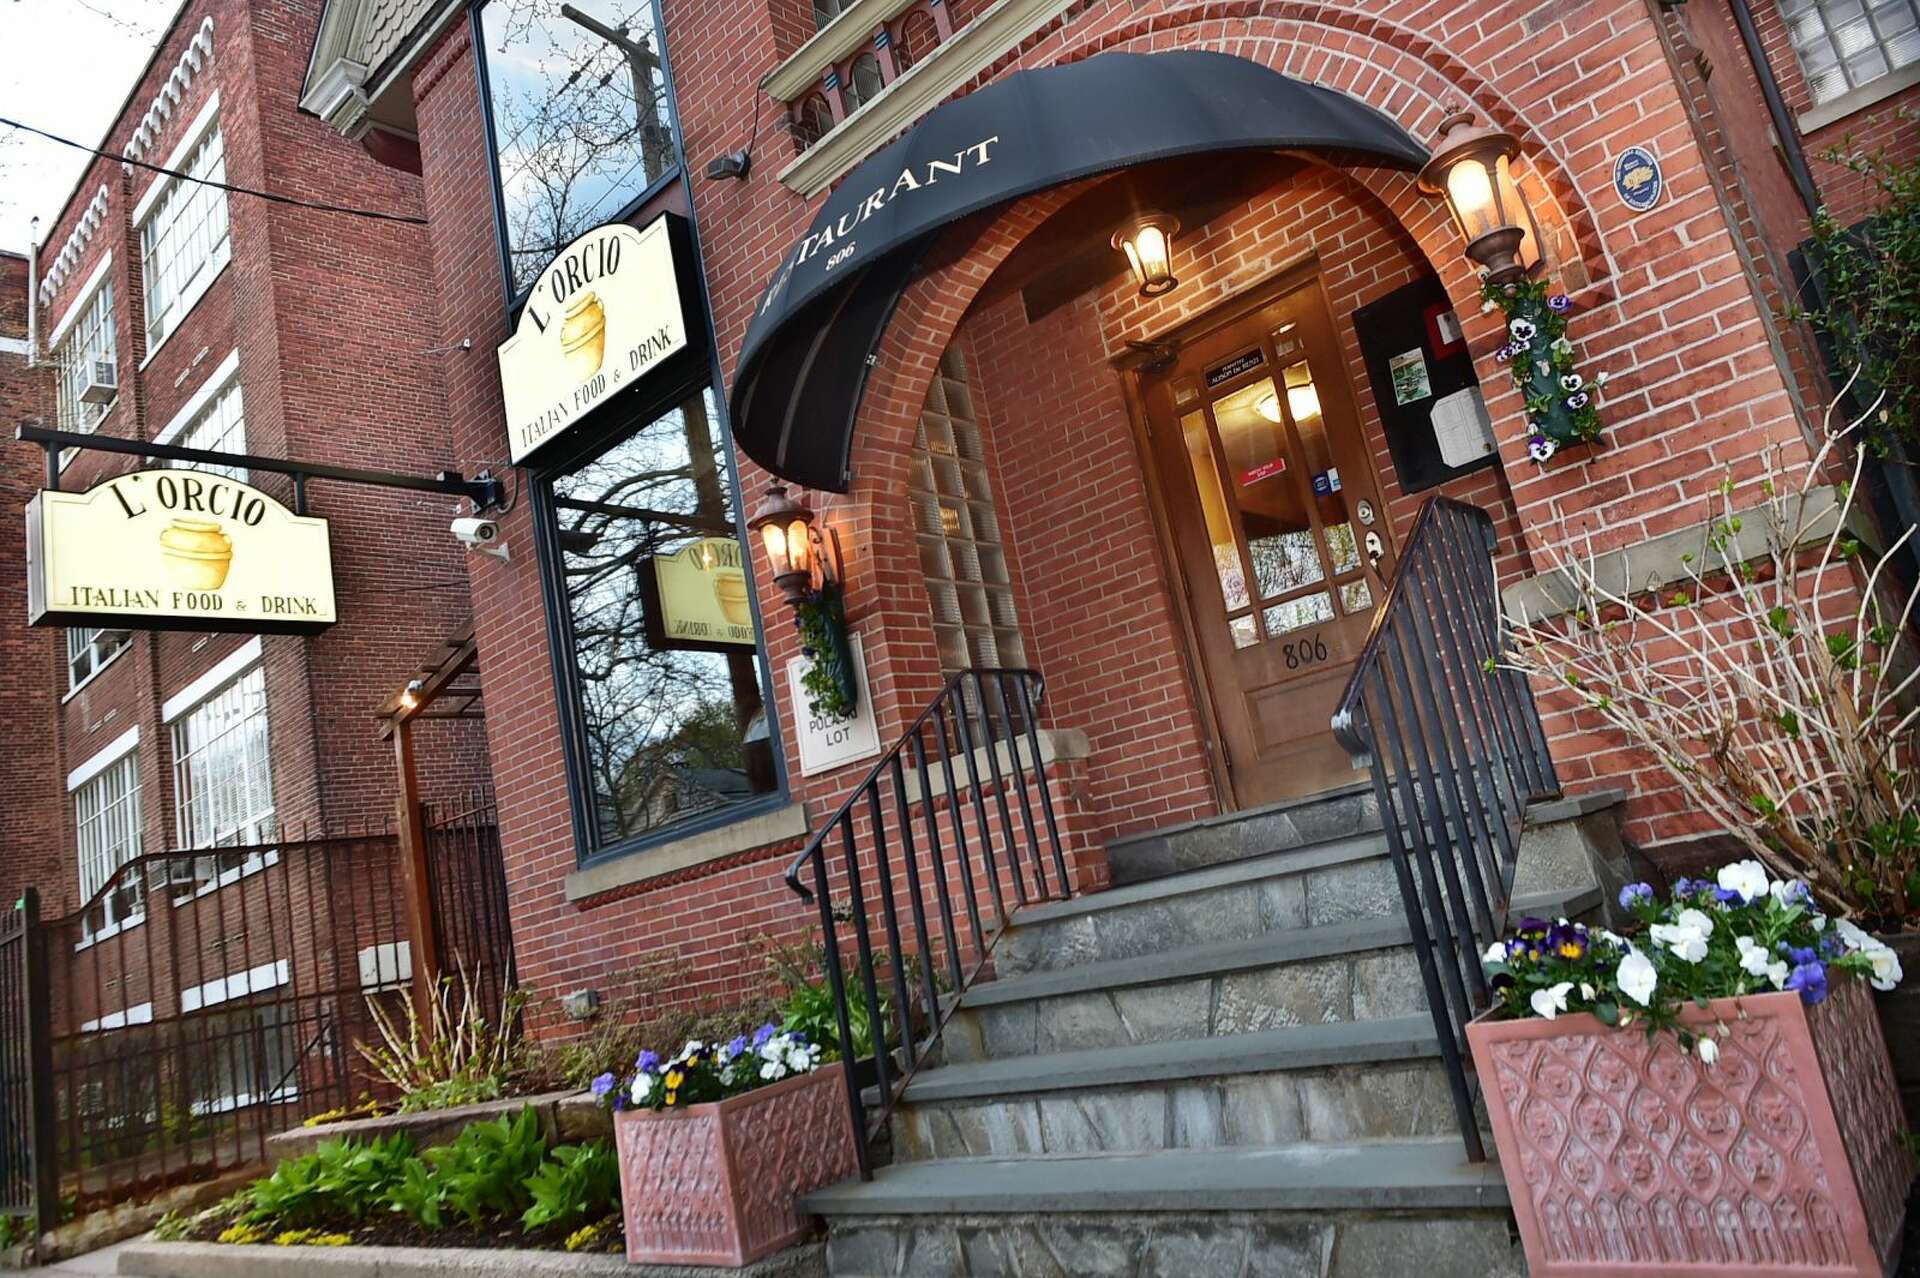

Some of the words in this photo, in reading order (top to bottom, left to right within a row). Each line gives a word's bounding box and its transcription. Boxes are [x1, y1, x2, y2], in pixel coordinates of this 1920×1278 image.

[760, 136, 999, 316] TAURANT
[826, 241, 857, 271] 806
[527, 235, 621, 334] L'ORCIO
[521, 400, 568, 448] ITALIAN
[574, 374, 606, 411] FOOD
[613, 369, 621, 383] &
[630, 325, 672, 372] DRINK
[108, 475, 266, 527] L'ORCIO
[71, 586, 160, 609] ITALIAN
[172, 592, 223, 611] FOOD
[236, 601, 247, 612] &
[262, 596, 318, 615] DRINK
[1282, 633, 1328, 670] 806
[826, 726, 850, 747] LOT
